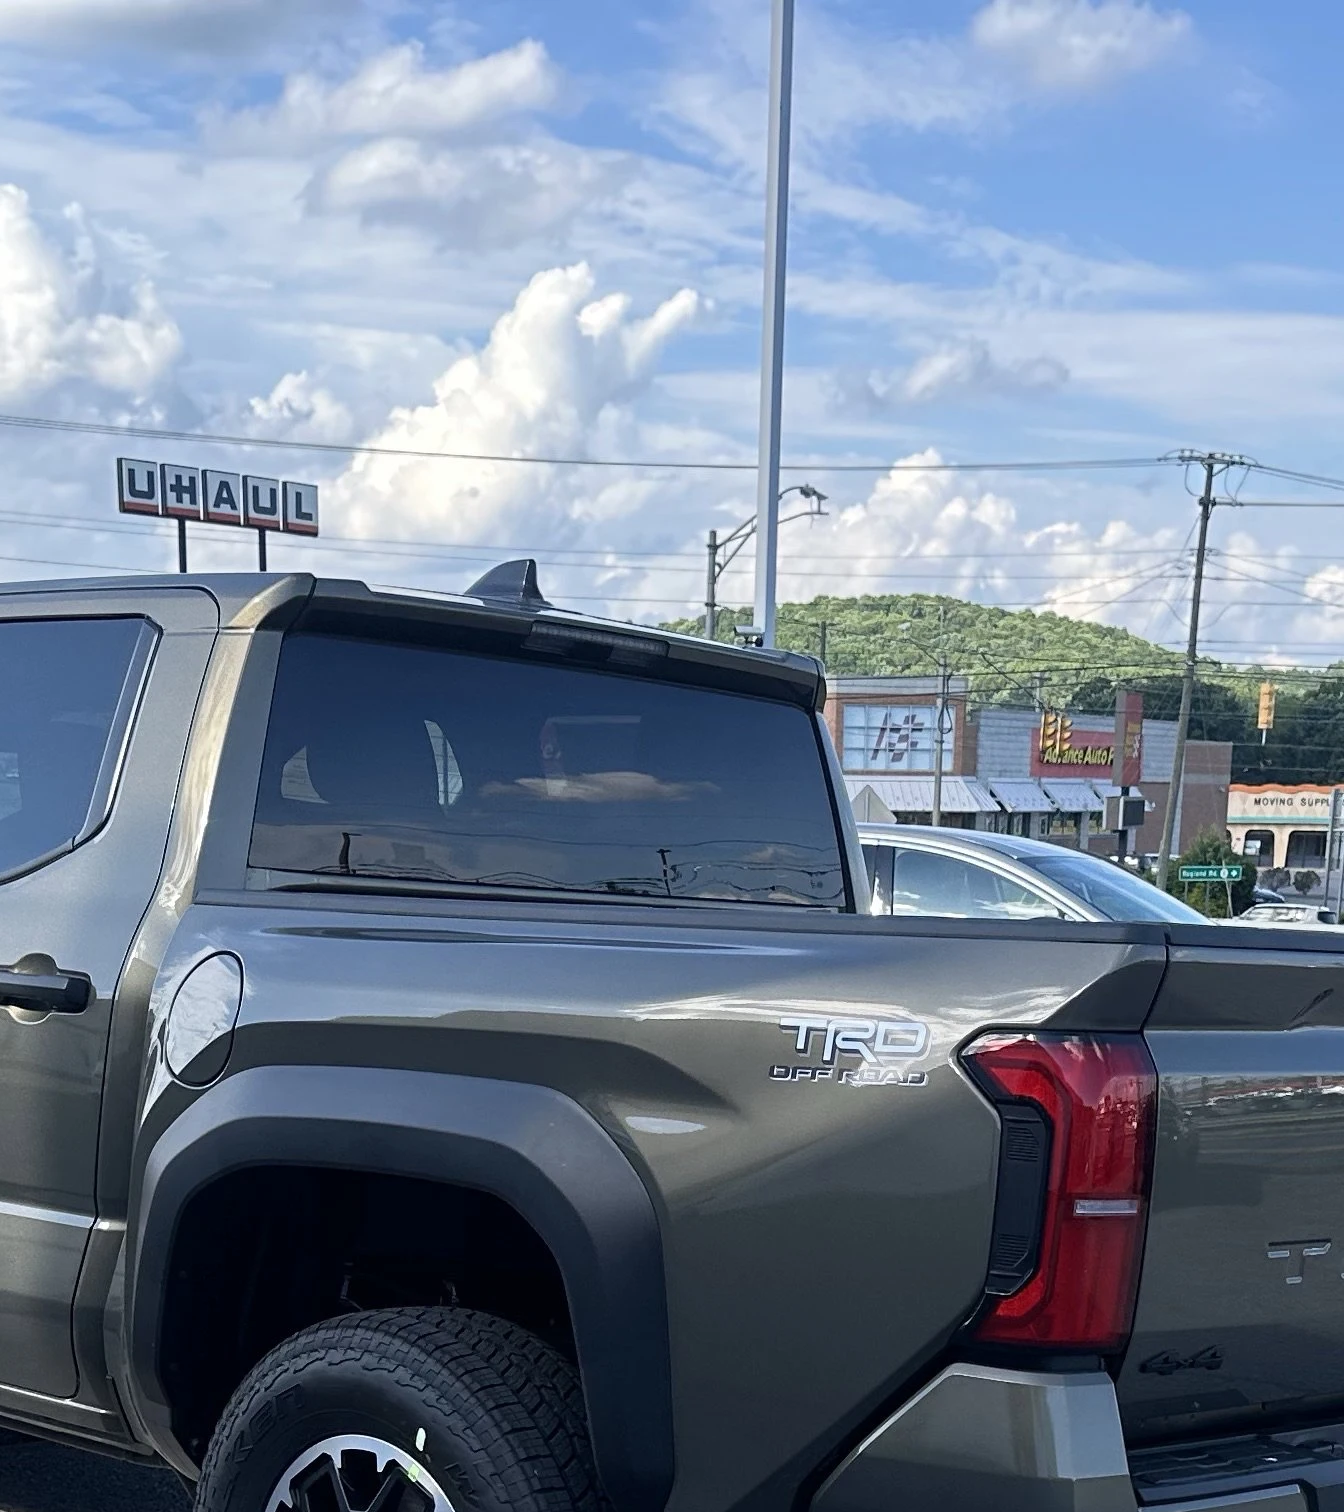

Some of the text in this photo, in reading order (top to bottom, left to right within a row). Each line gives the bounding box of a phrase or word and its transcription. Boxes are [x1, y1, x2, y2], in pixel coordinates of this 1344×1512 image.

[1083, 745, 1108, 766] Auto
[1254, 797, 1330, 807] MOVING SUPPL
[780, 1017, 928, 1065] TRD
[769, 1065, 929, 1087] OFF ROAD
